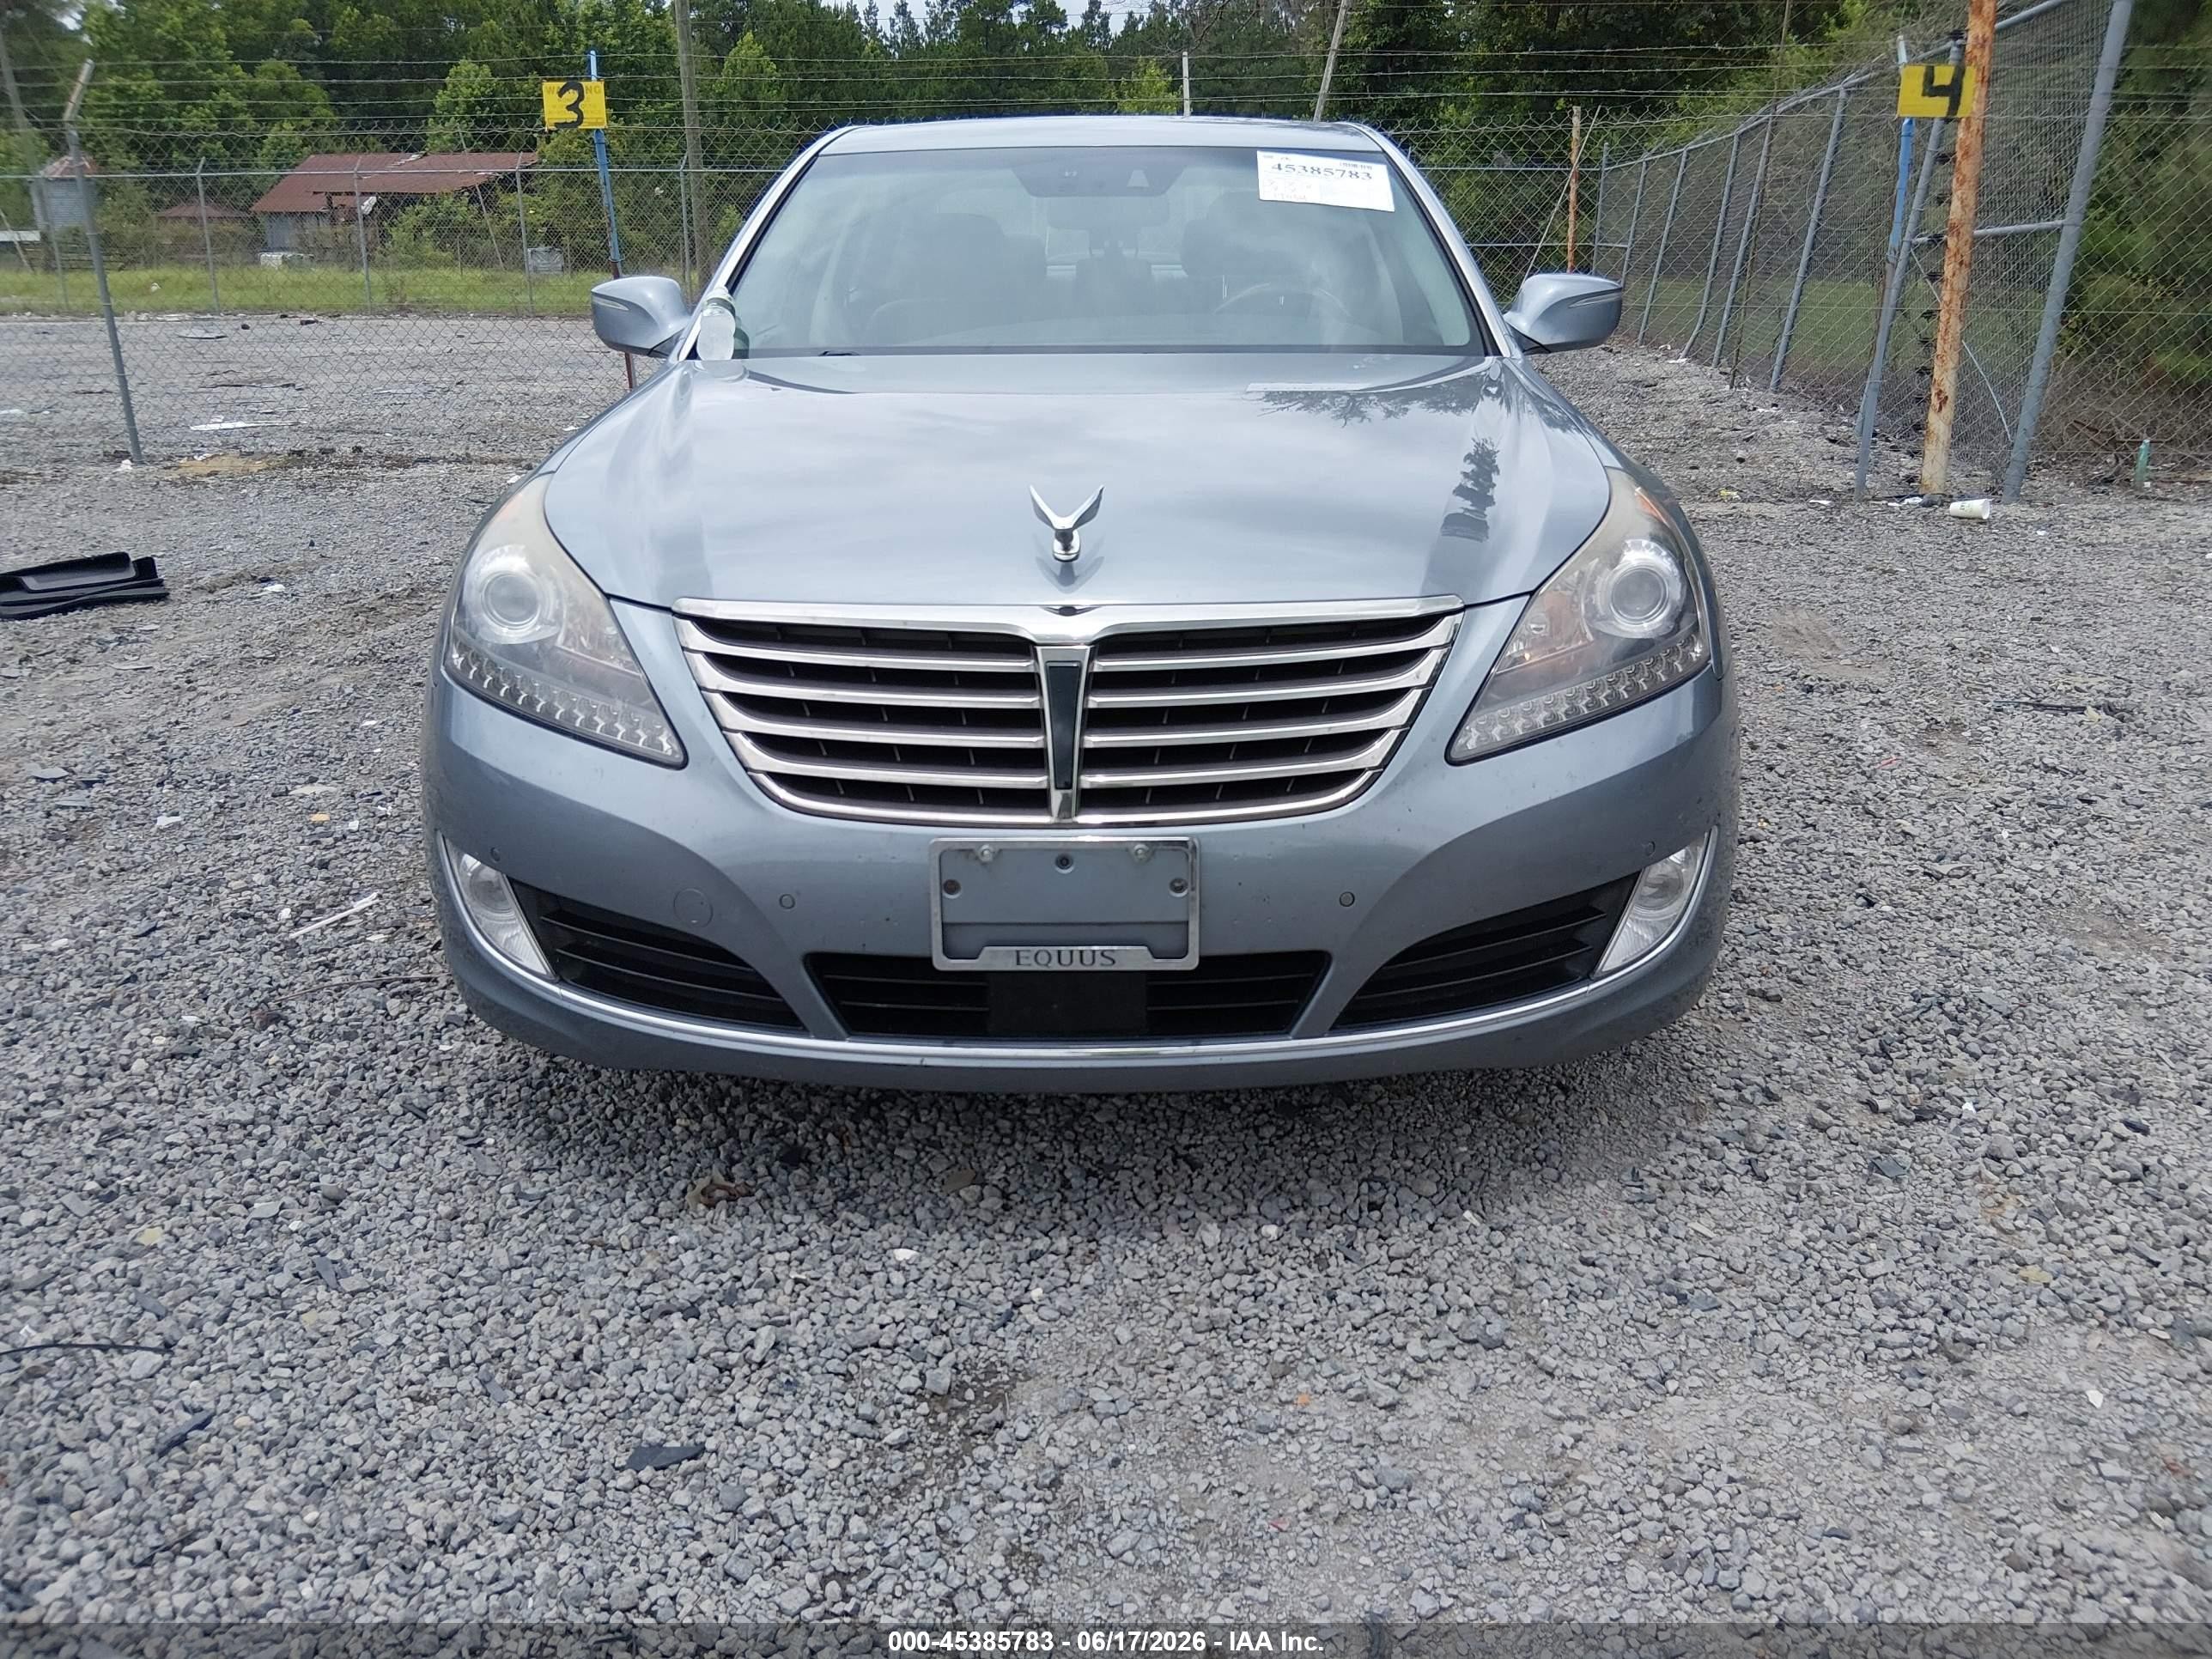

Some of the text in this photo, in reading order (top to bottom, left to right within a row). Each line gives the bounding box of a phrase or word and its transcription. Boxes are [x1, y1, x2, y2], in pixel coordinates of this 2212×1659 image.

[554, 81, 586, 129] 3
[1922, 64, 1966, 118] 4
[1271, 161, 1373, 181] 45385783
[1015, 949, 1117, 968] EQUUS
